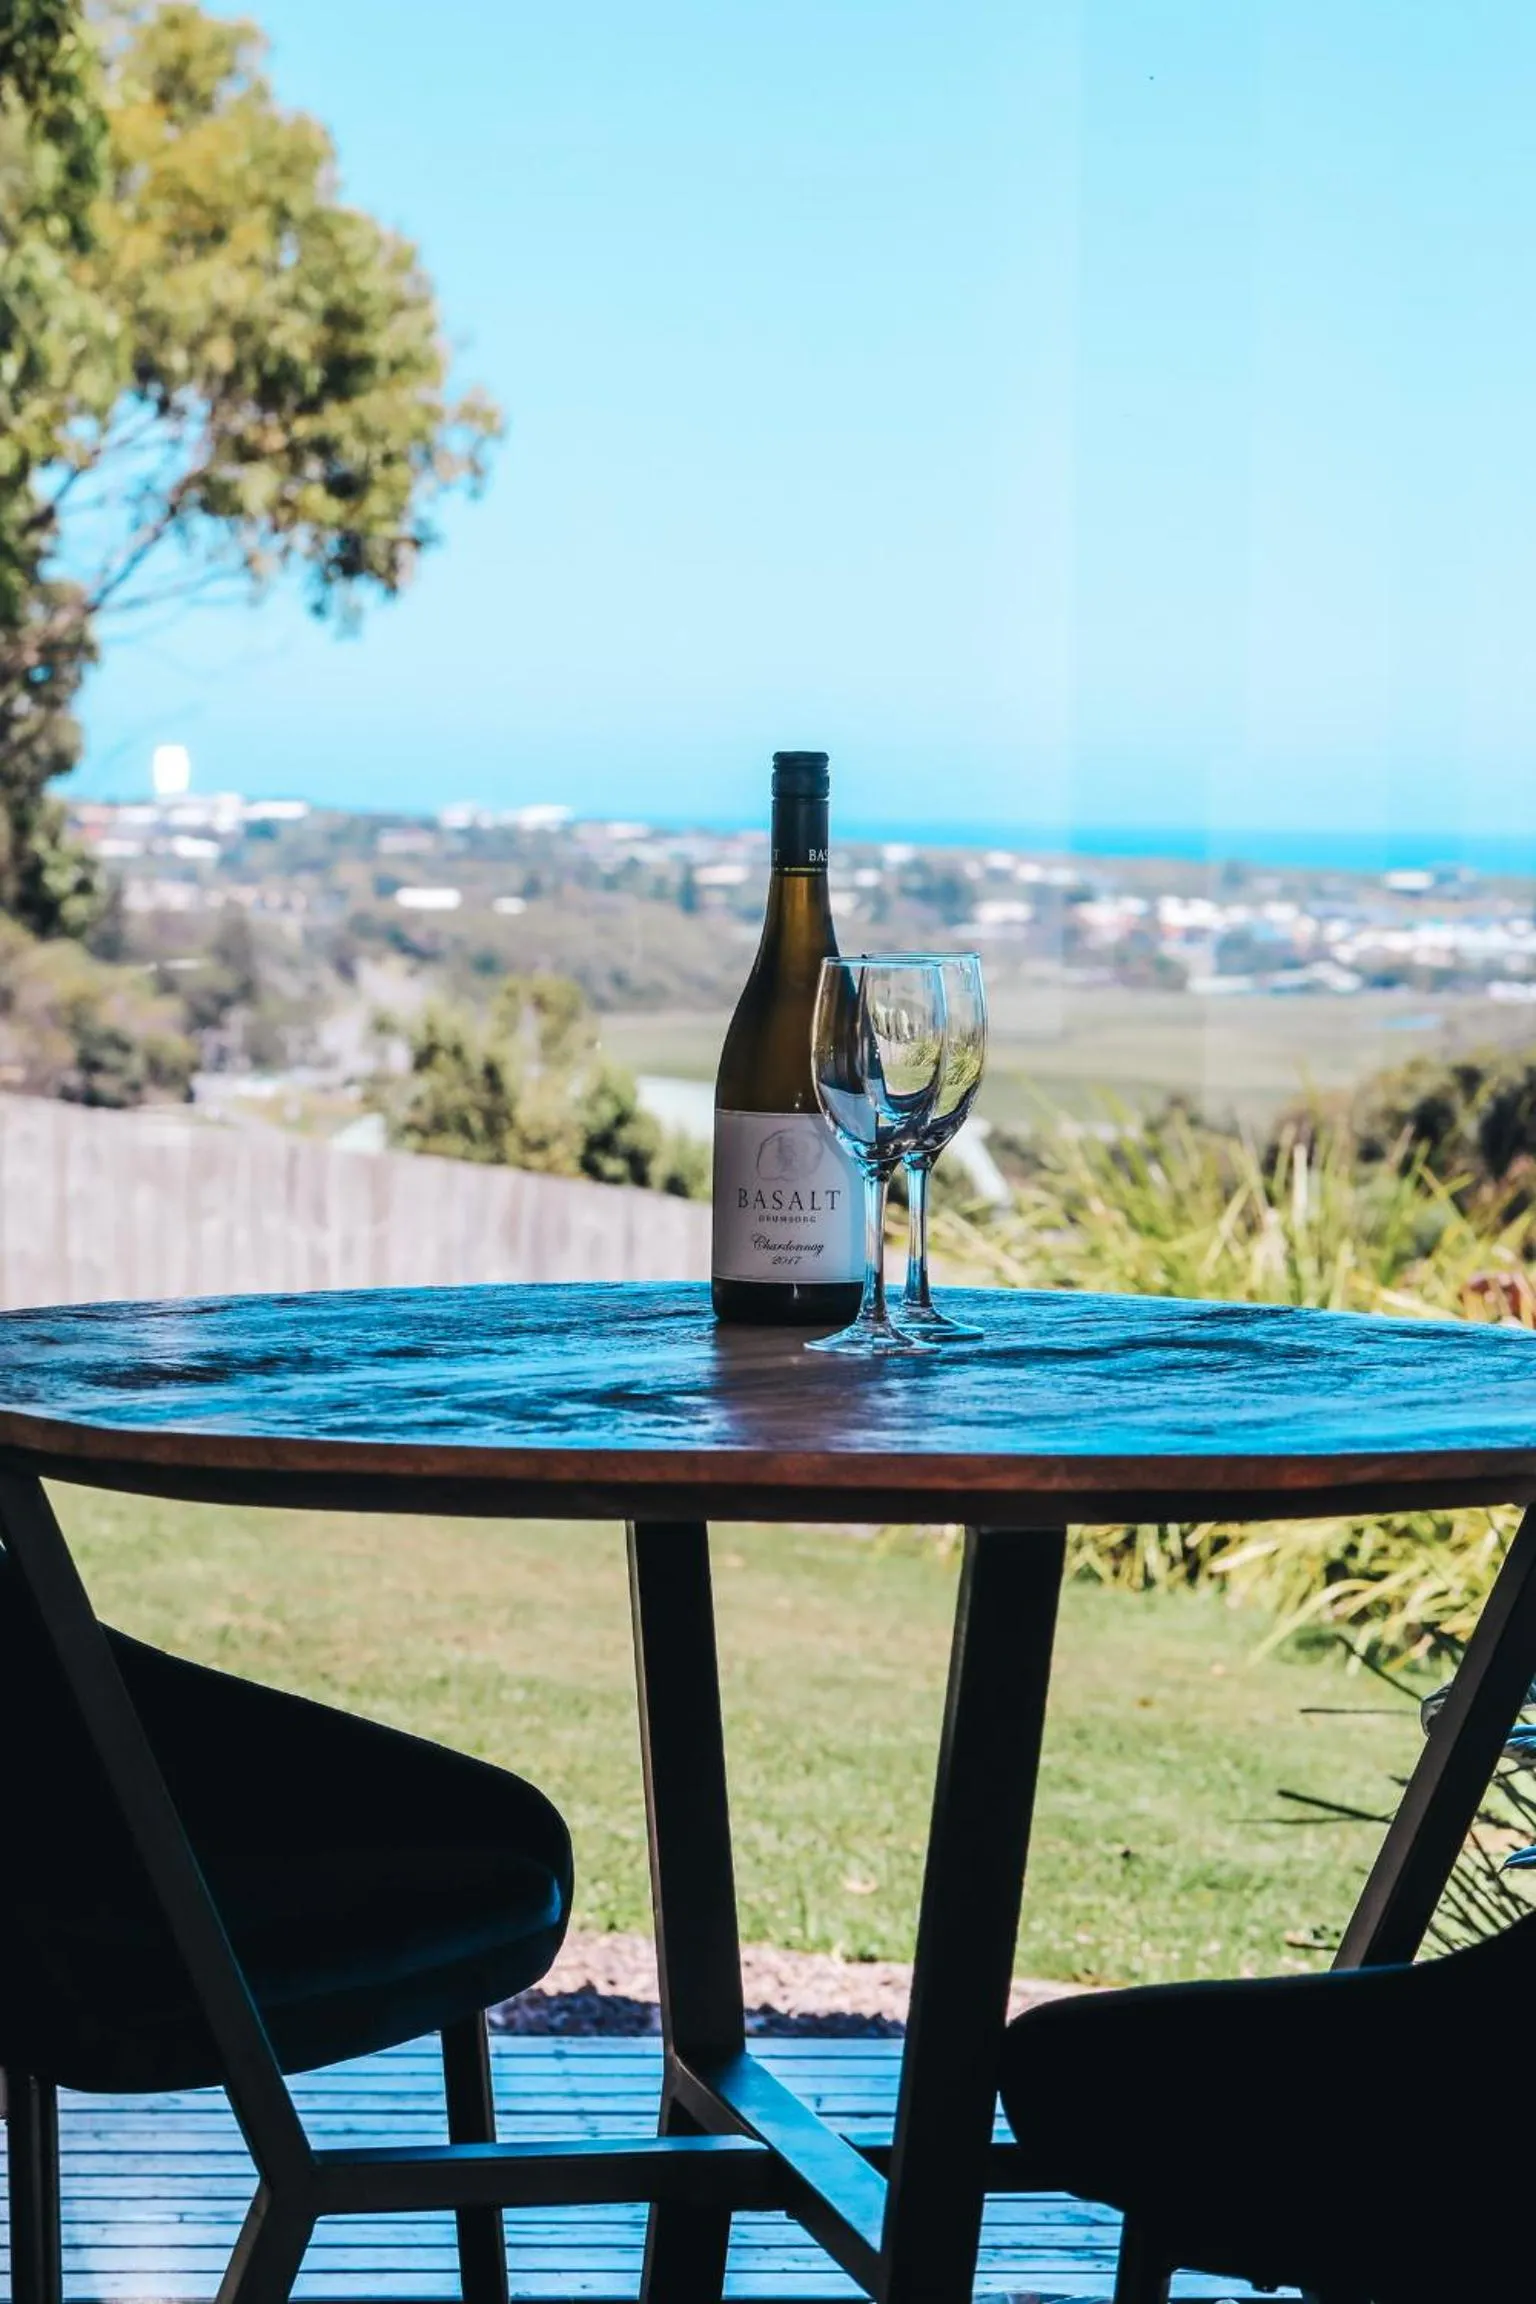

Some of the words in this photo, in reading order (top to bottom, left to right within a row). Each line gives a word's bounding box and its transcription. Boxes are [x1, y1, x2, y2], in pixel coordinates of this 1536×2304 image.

[738, 1187, 841, 1211] BASALT
[751, 1232, 824, 1257] Chardonnay
[771, 1255, 803, 1265] 2017
